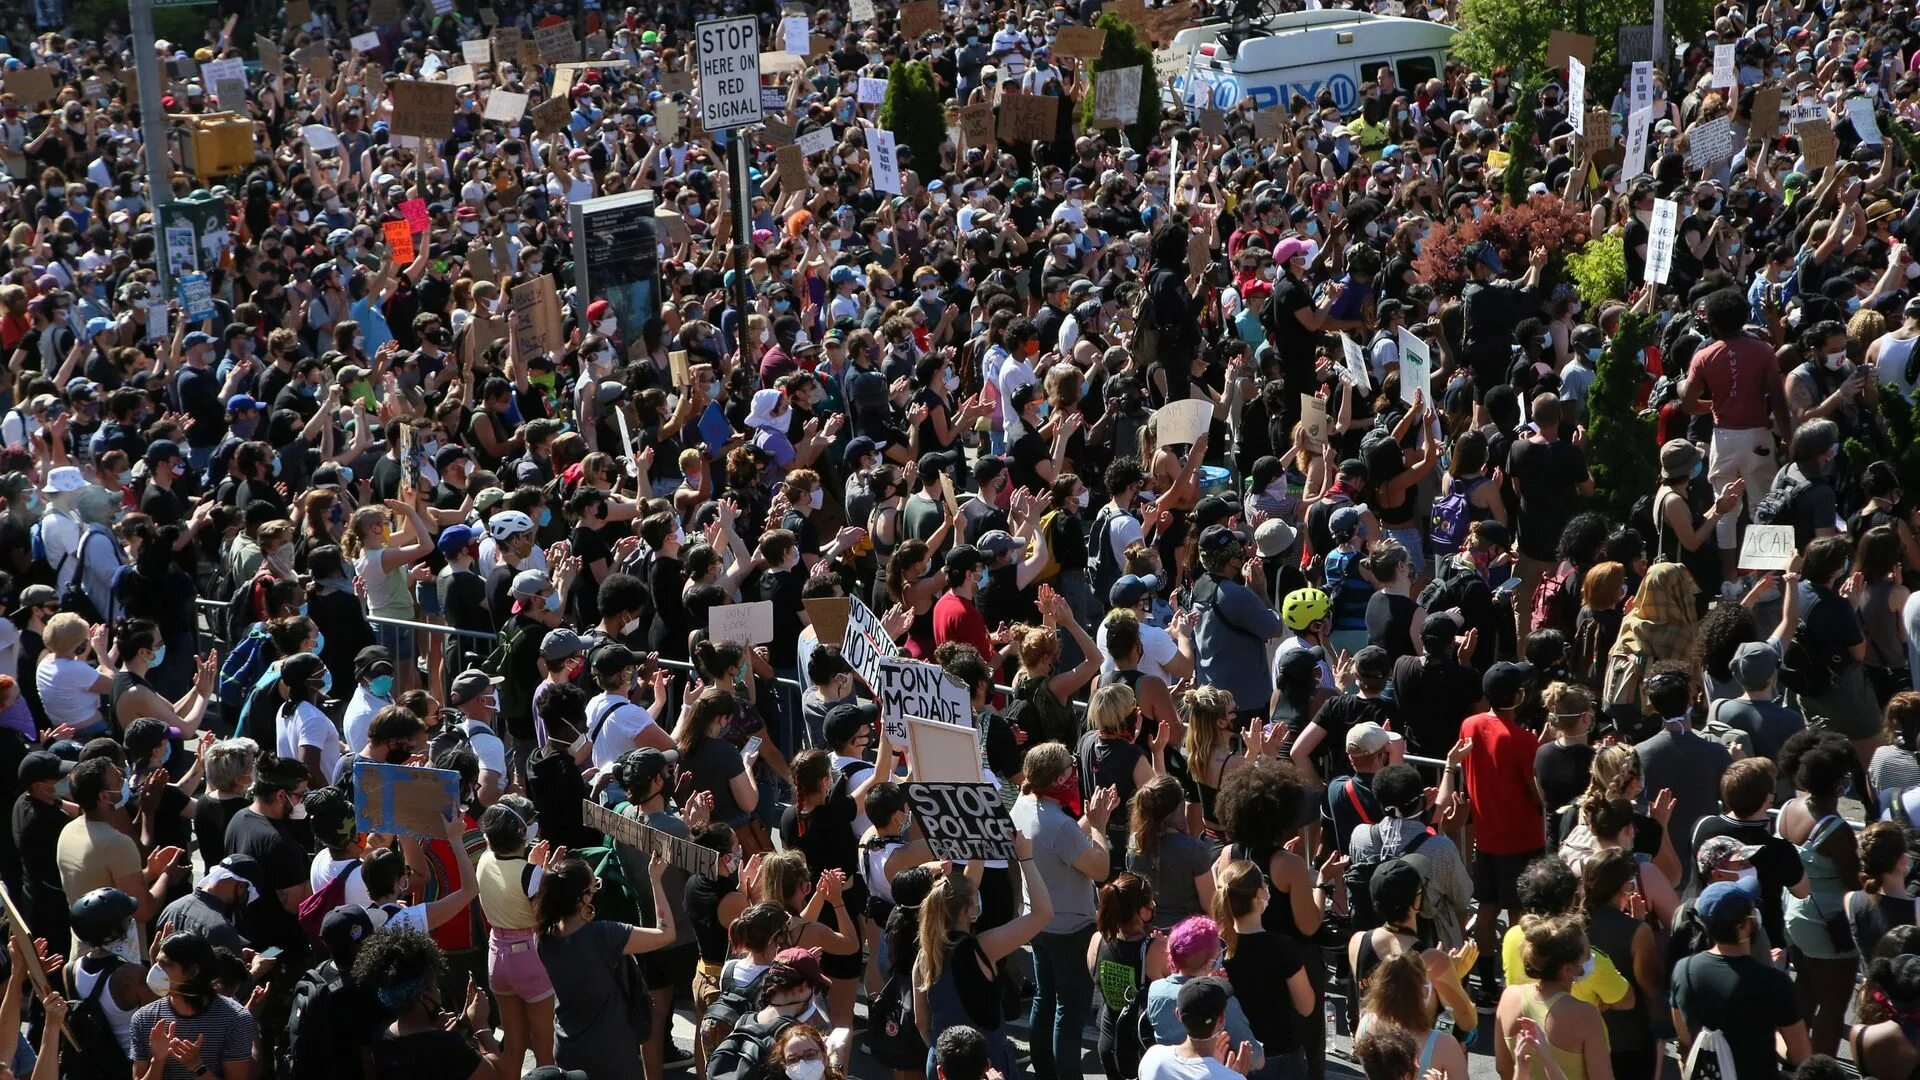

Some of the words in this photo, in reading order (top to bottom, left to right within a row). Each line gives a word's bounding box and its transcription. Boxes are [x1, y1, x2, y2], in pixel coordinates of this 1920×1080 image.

[702, 25, 753, 54] STOP
[704, 57, 734, 76] HERE
[740, 54, 755, 70] ON
[718, 78, 744, 96] RED
[708, 98, 757, 120] SIGNAL
[964, 110, 986, 120] UNITED
[1798, 106, 1821, 118] WHITE
[800, 134, 821, 144] BLACK
[1165, 404, 1182, 417] AM
[1744, 531, 1792, 554] ACAB
[724, 620, 748, 632] LOOK
[850, 597, 864, 624] NO
[864, 610, 899, 657] JUSTIC
[844, 627, 864, 669] NO
[863, 646, 882, 700] PEA
[880, 664, 943, 700] TONY
[884, 689, 961, 724] MCDADE
[908, 784, 1002, 817] STOP
[921, 815, 1014, 842] POLICE
[586, 800, 627, 844] BLACK
[628, 821, 663, 857] LIVES
[668, 836, 717, 881] MATTER
[927, 838, 1016, 860] BRUTALIT
